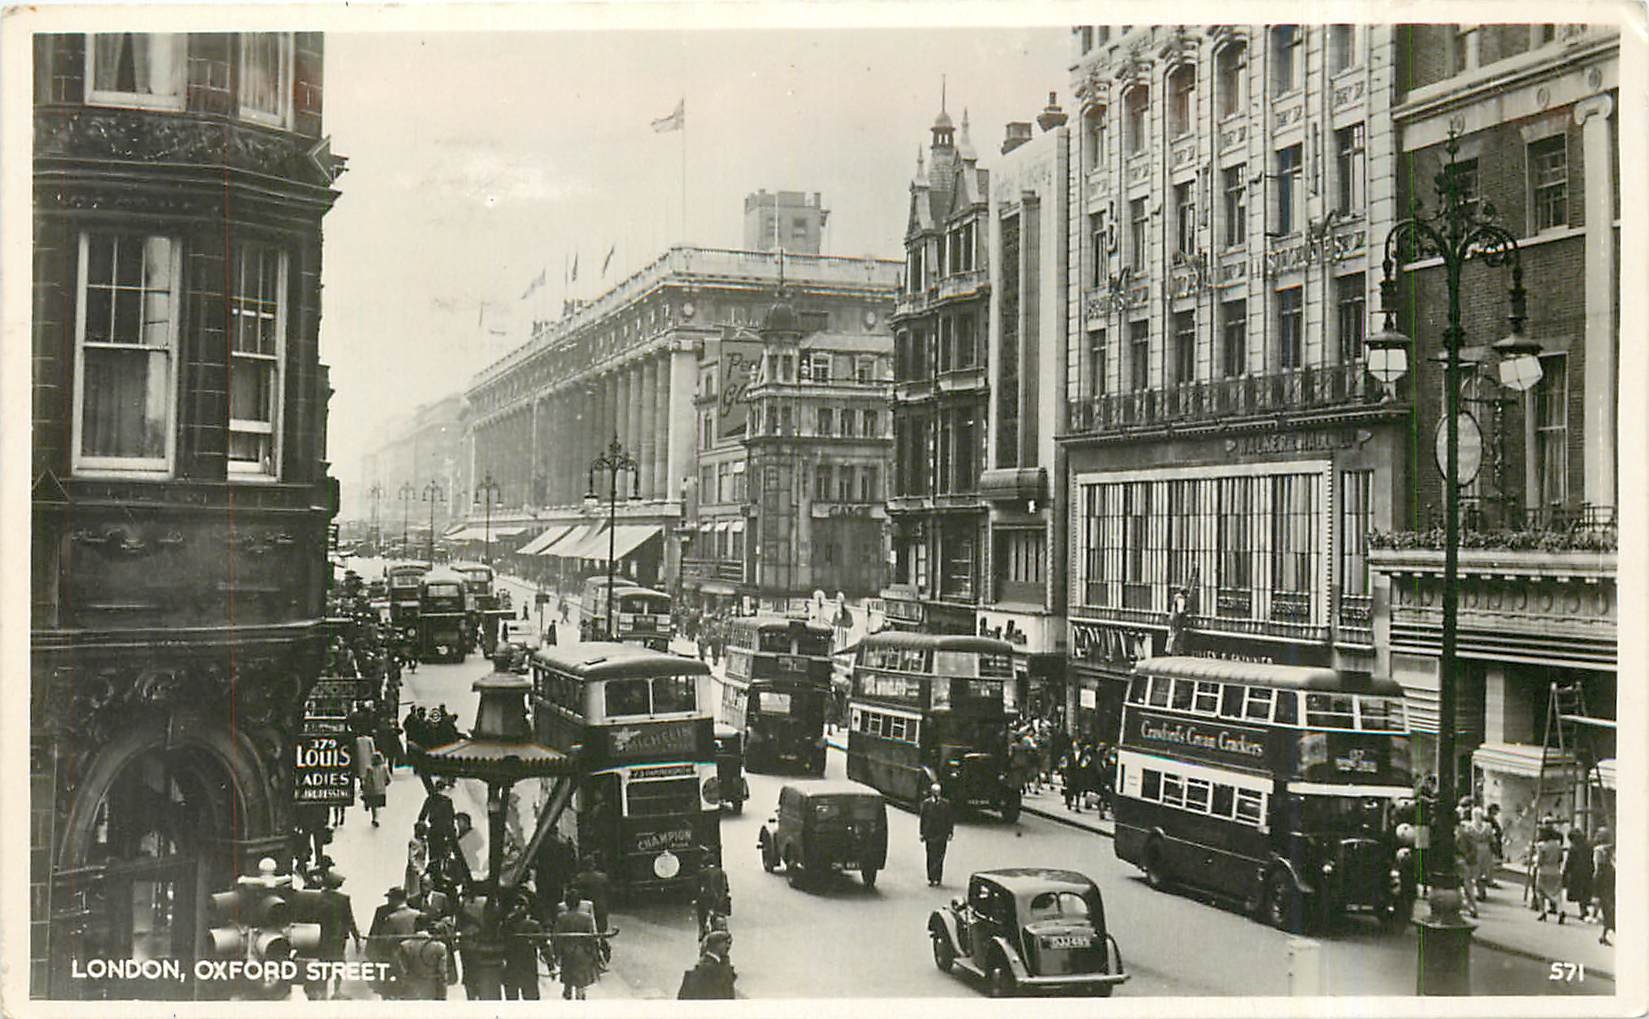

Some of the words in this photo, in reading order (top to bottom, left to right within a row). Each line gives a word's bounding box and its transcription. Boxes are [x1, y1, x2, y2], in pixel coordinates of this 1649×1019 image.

[310, 739, 337, 749] 379
[297, 745, 351, 767] LOUIS
[639, 830, 692, 850] CHAMPION
